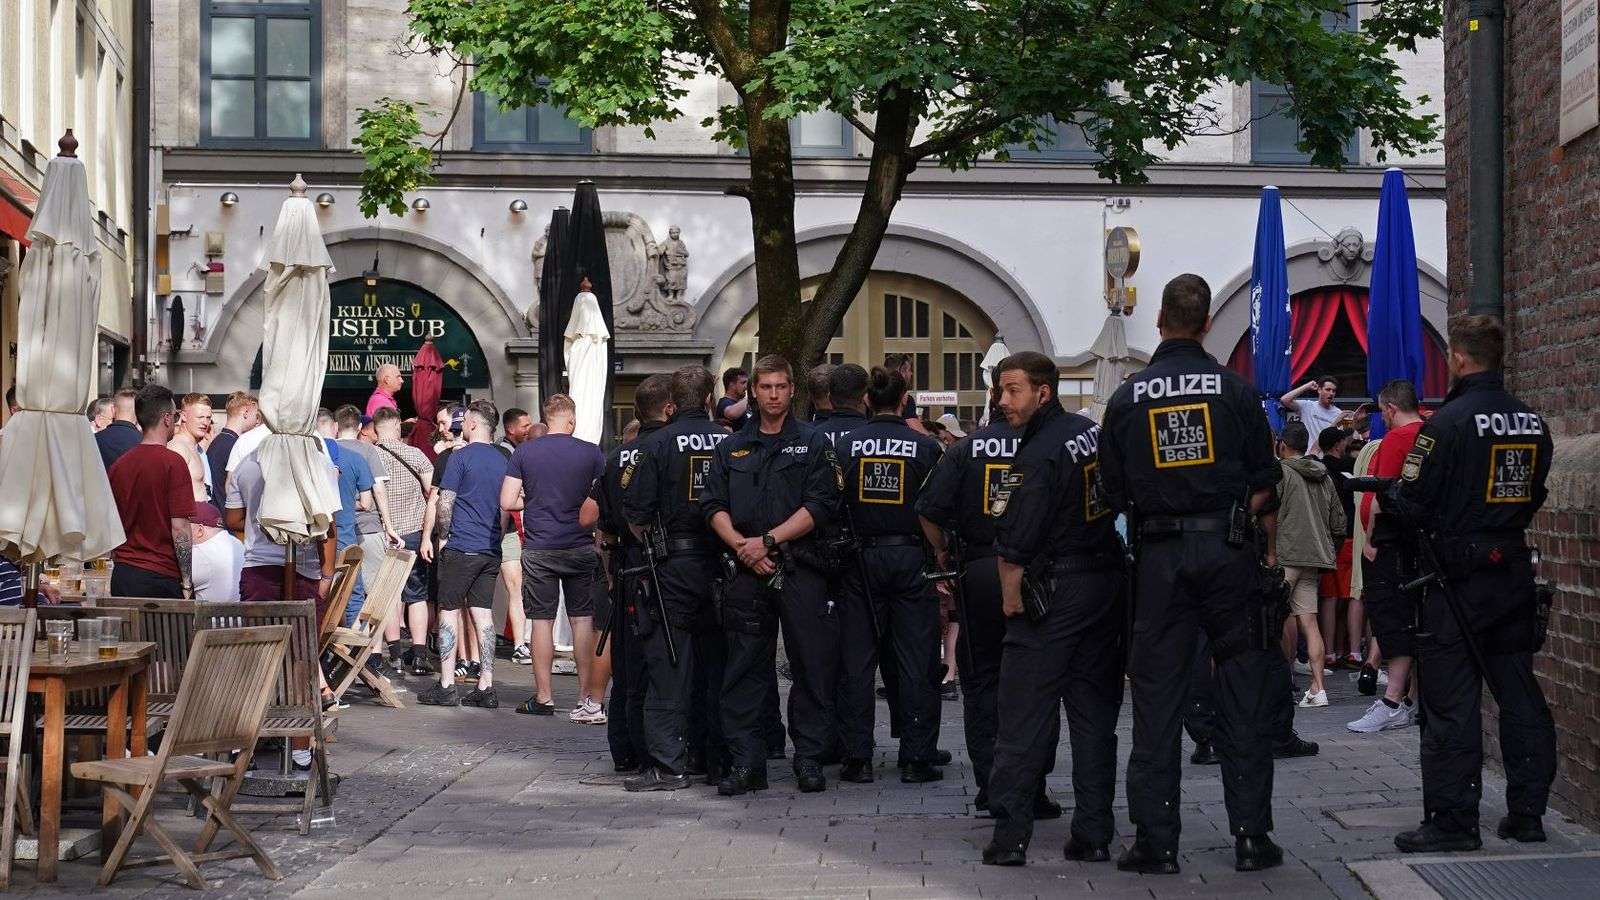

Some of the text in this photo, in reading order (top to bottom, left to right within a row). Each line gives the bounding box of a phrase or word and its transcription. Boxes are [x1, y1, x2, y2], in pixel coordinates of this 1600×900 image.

[337, 305, 405, 318] KILIANS
[330, 318, 445, 338] ISH PUB
[353, 337, 366, 345] AM
[329, 354, 361, 372] KELLYS
[1132, 373, 1222, 403] POLIZEI
[1167, 410, 1190, 428] BY
[1473, 412, 1544, 437] POLIZEI
[676, 433, 729, 452] POLIZ
[1157, 425, 1205, 446] M 7336
[851, 438, 917, 457] POLIZEI
[972, 437, 1021, 458] POLI
[1505, 449, 1524, 466] BY
[873, 462, 891, 476] BY
[864, 475, 899, 489] M 7332
